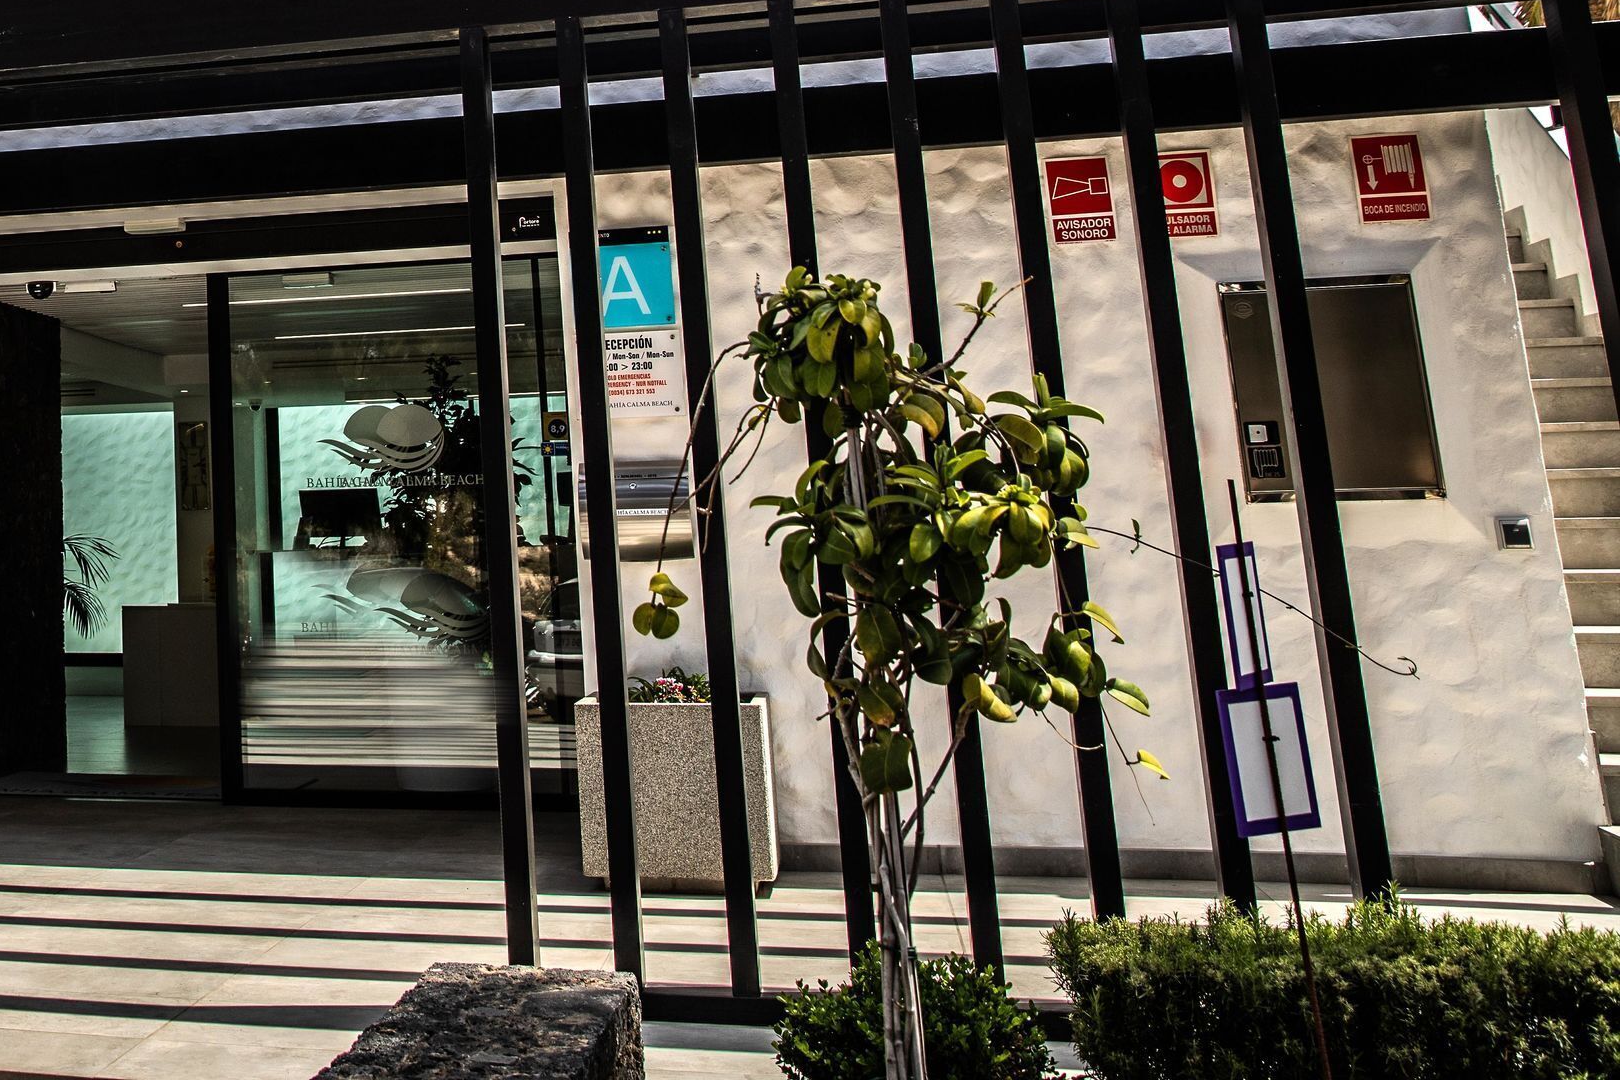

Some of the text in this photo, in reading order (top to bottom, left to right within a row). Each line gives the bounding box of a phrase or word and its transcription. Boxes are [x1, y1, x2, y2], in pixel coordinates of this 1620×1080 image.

[1364, 202, 1427, 215] BOCA DE INCENDIO
[1056, 217, 1112, 230] AVISADOR
[1061, 228, 1109, 240] SONORO
[1173, 224, 1214, 235] ALARMA
[602, 255, 652, 317] A
[605, 335, 653, 350] ECEPCIÓN
[646, 350, 674, 359] Mon-Sun
[631, 361, 653, 370] 23:00
[618, 373, 651, 381] EMERGENCIAS
[627, 400, 651, 408] CALMA
[550, 424, 566, 435] 8,9
